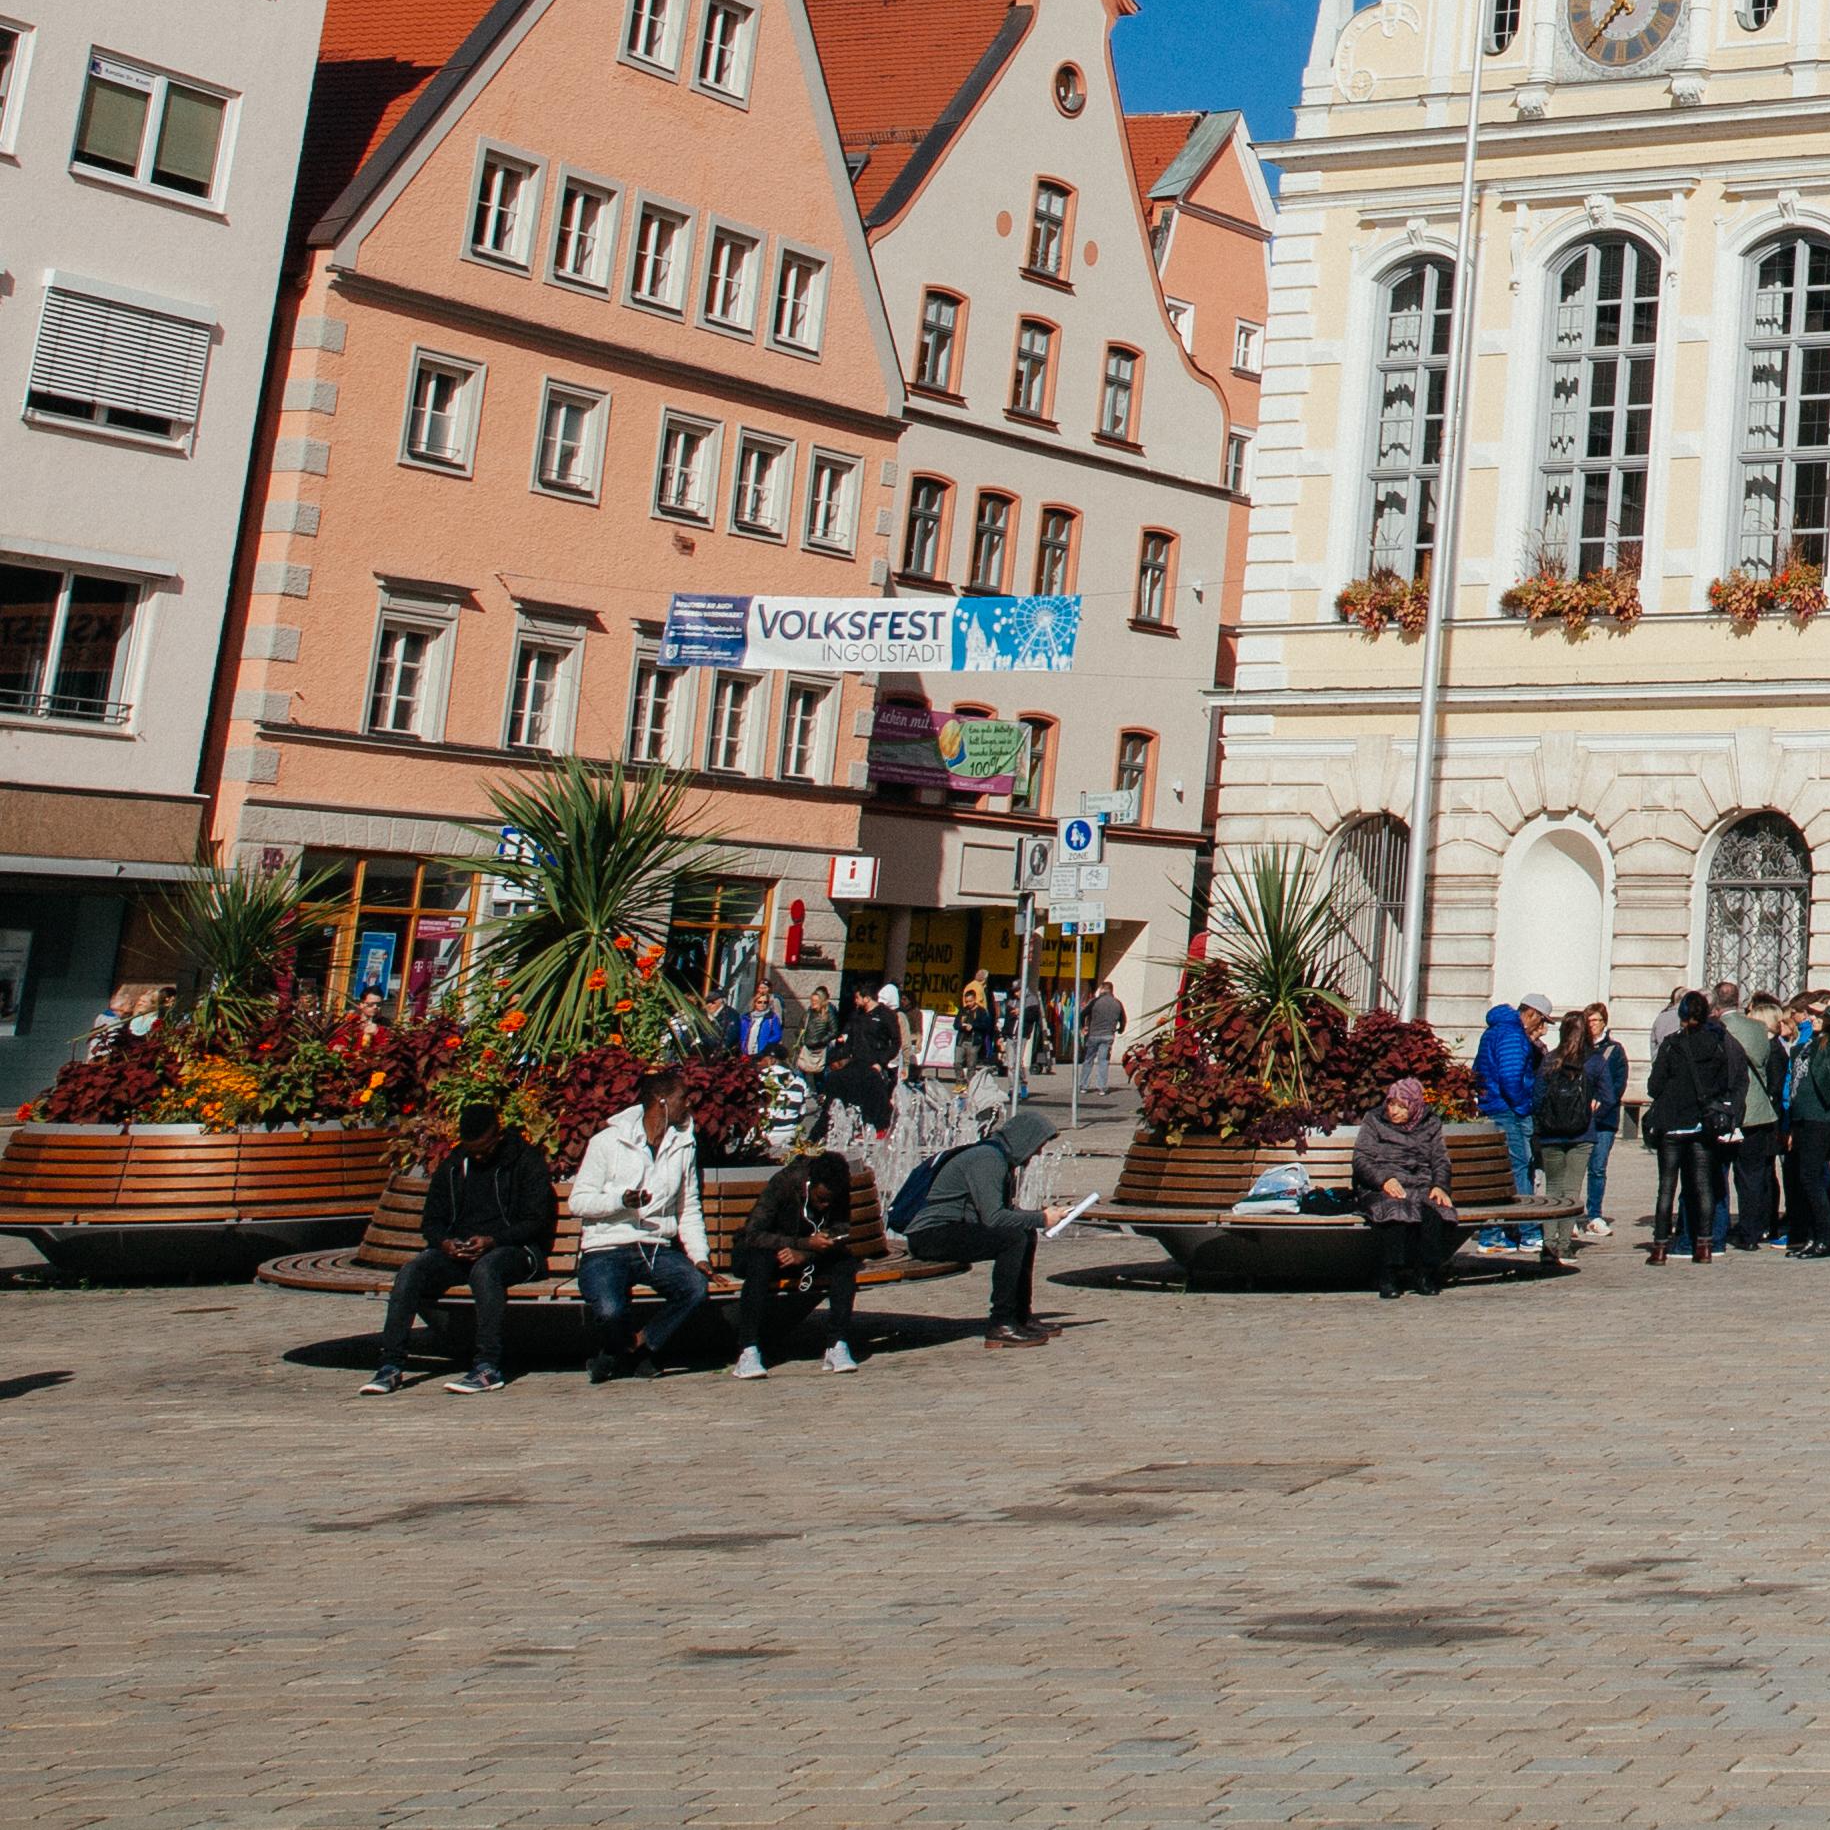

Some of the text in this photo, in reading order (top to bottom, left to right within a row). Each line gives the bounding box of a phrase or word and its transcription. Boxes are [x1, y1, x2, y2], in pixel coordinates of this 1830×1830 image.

[758, 604, 947, 641] VOLKSFEST
[822, 643, 945, 662] INGOLSTADT
[1068, 852, 1089, 861] ZONE
[907, 941, 953, 964] GRAND
[904, 971, 960, 994] PENING
